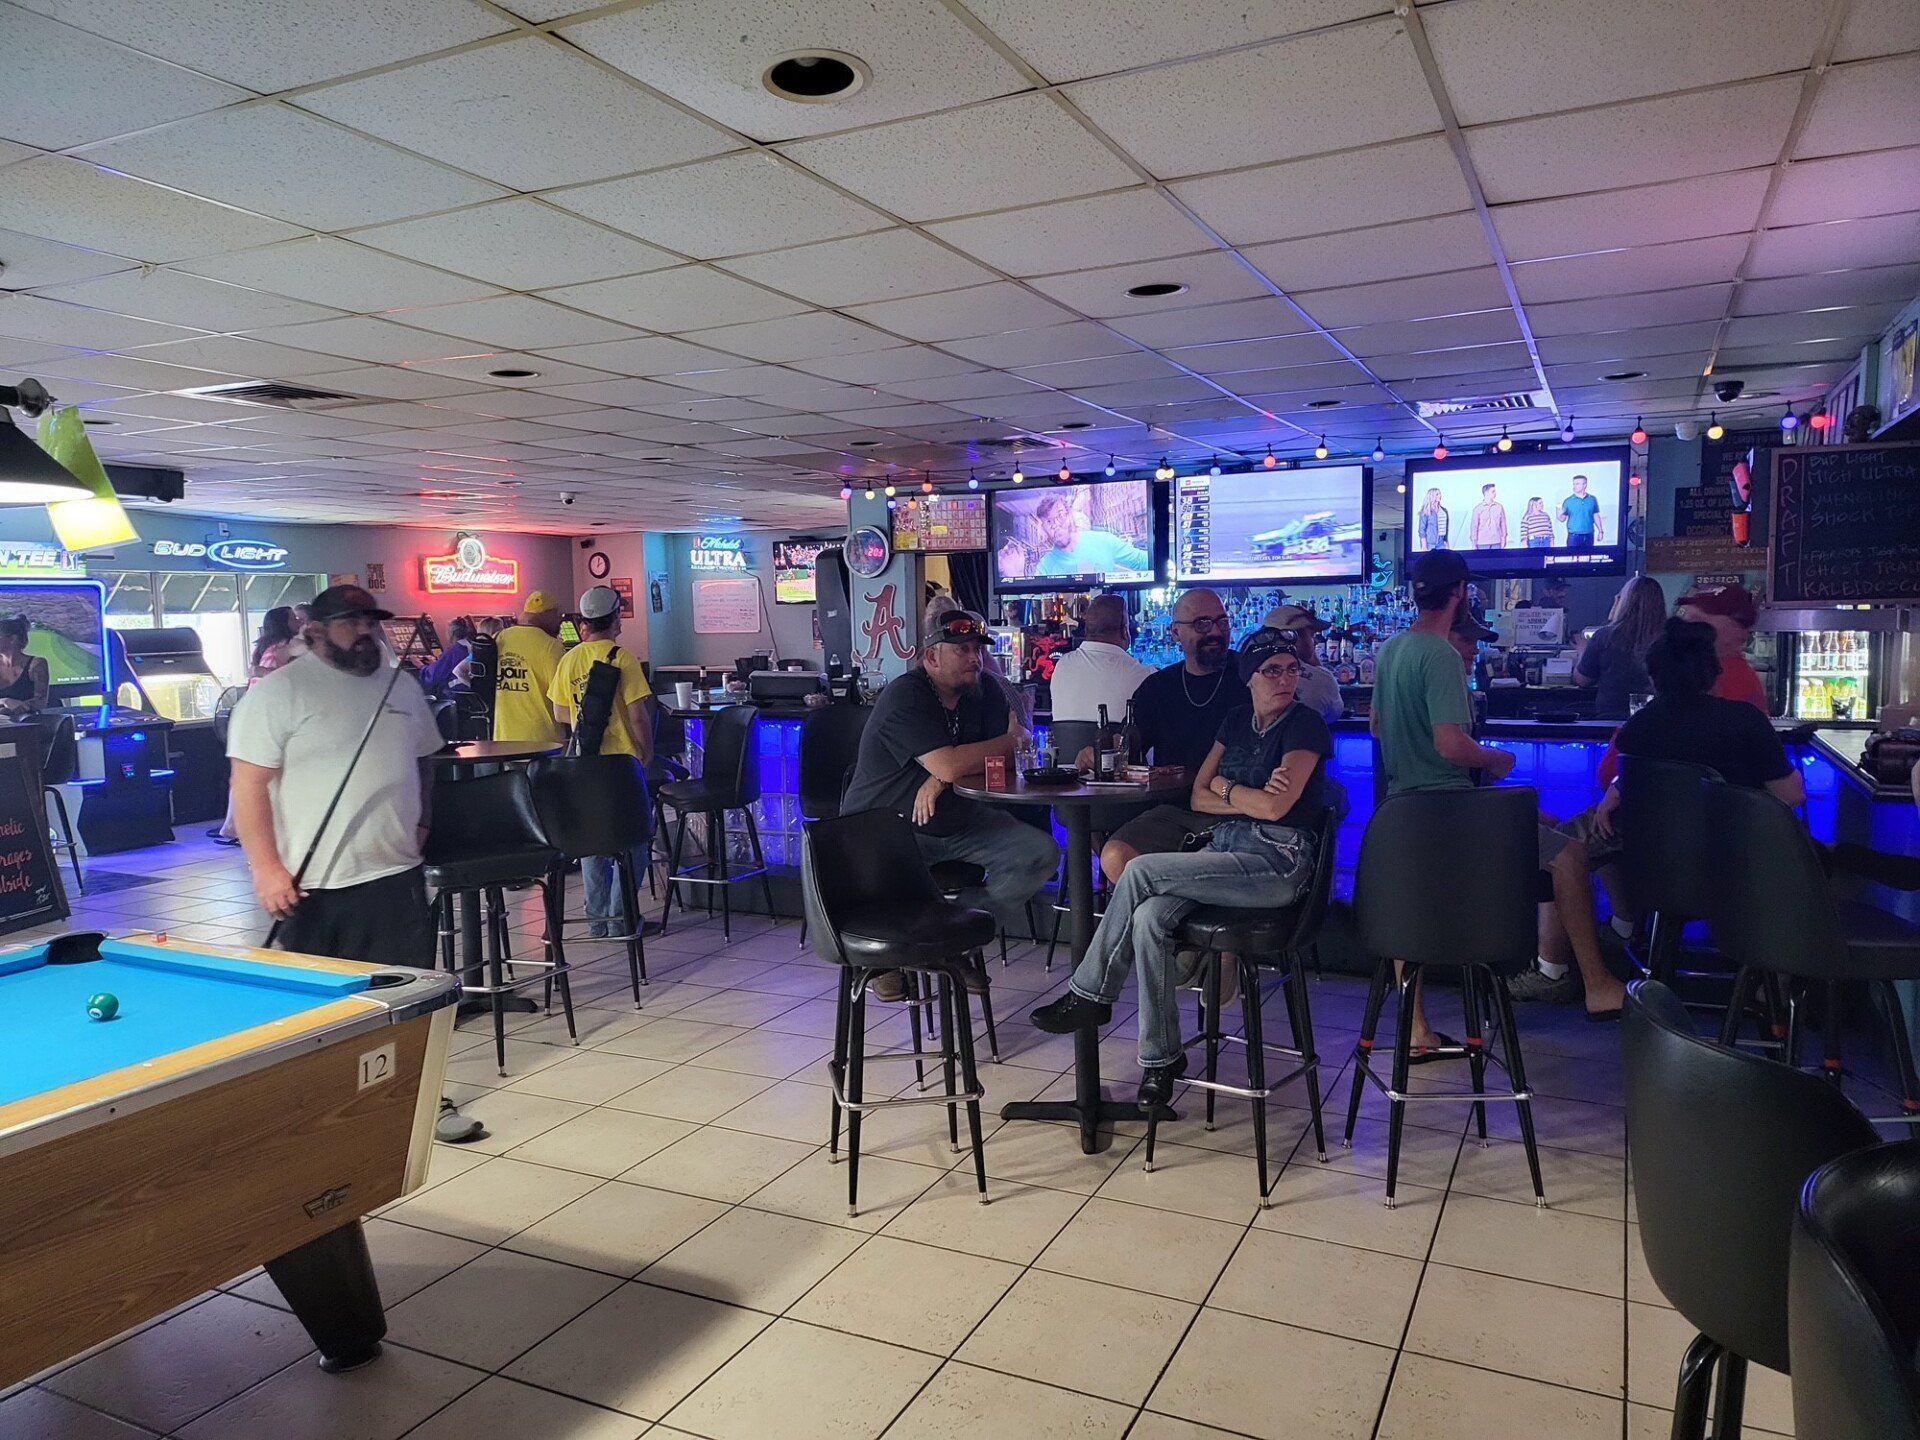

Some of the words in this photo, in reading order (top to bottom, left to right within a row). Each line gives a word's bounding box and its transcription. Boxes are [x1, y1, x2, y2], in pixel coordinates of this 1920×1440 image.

[1809, 454, 1839, 468] BUD
[1845, 450, 1889, 465] LIGHT
[1807, 469, 1852, 485] MICH
[1861, 464, 1917, 480] ULTRA
[1811, 507, 1876, 528] SHOCK
[17, 549, 58, 568] TEE
[154, 540, 206, 556] BUD
[221, 545, 288, 560] LIGHT
[690, 549, 747, 567] ULTRA
[429, 563, 515, 586] Budweiser
[1805, 561, 1863, 577] GHOST
[1697, 575, 1740, 584] JESSICA
[497, 667, 528, 682] your
[363, 1053, 388, 1085] 12
